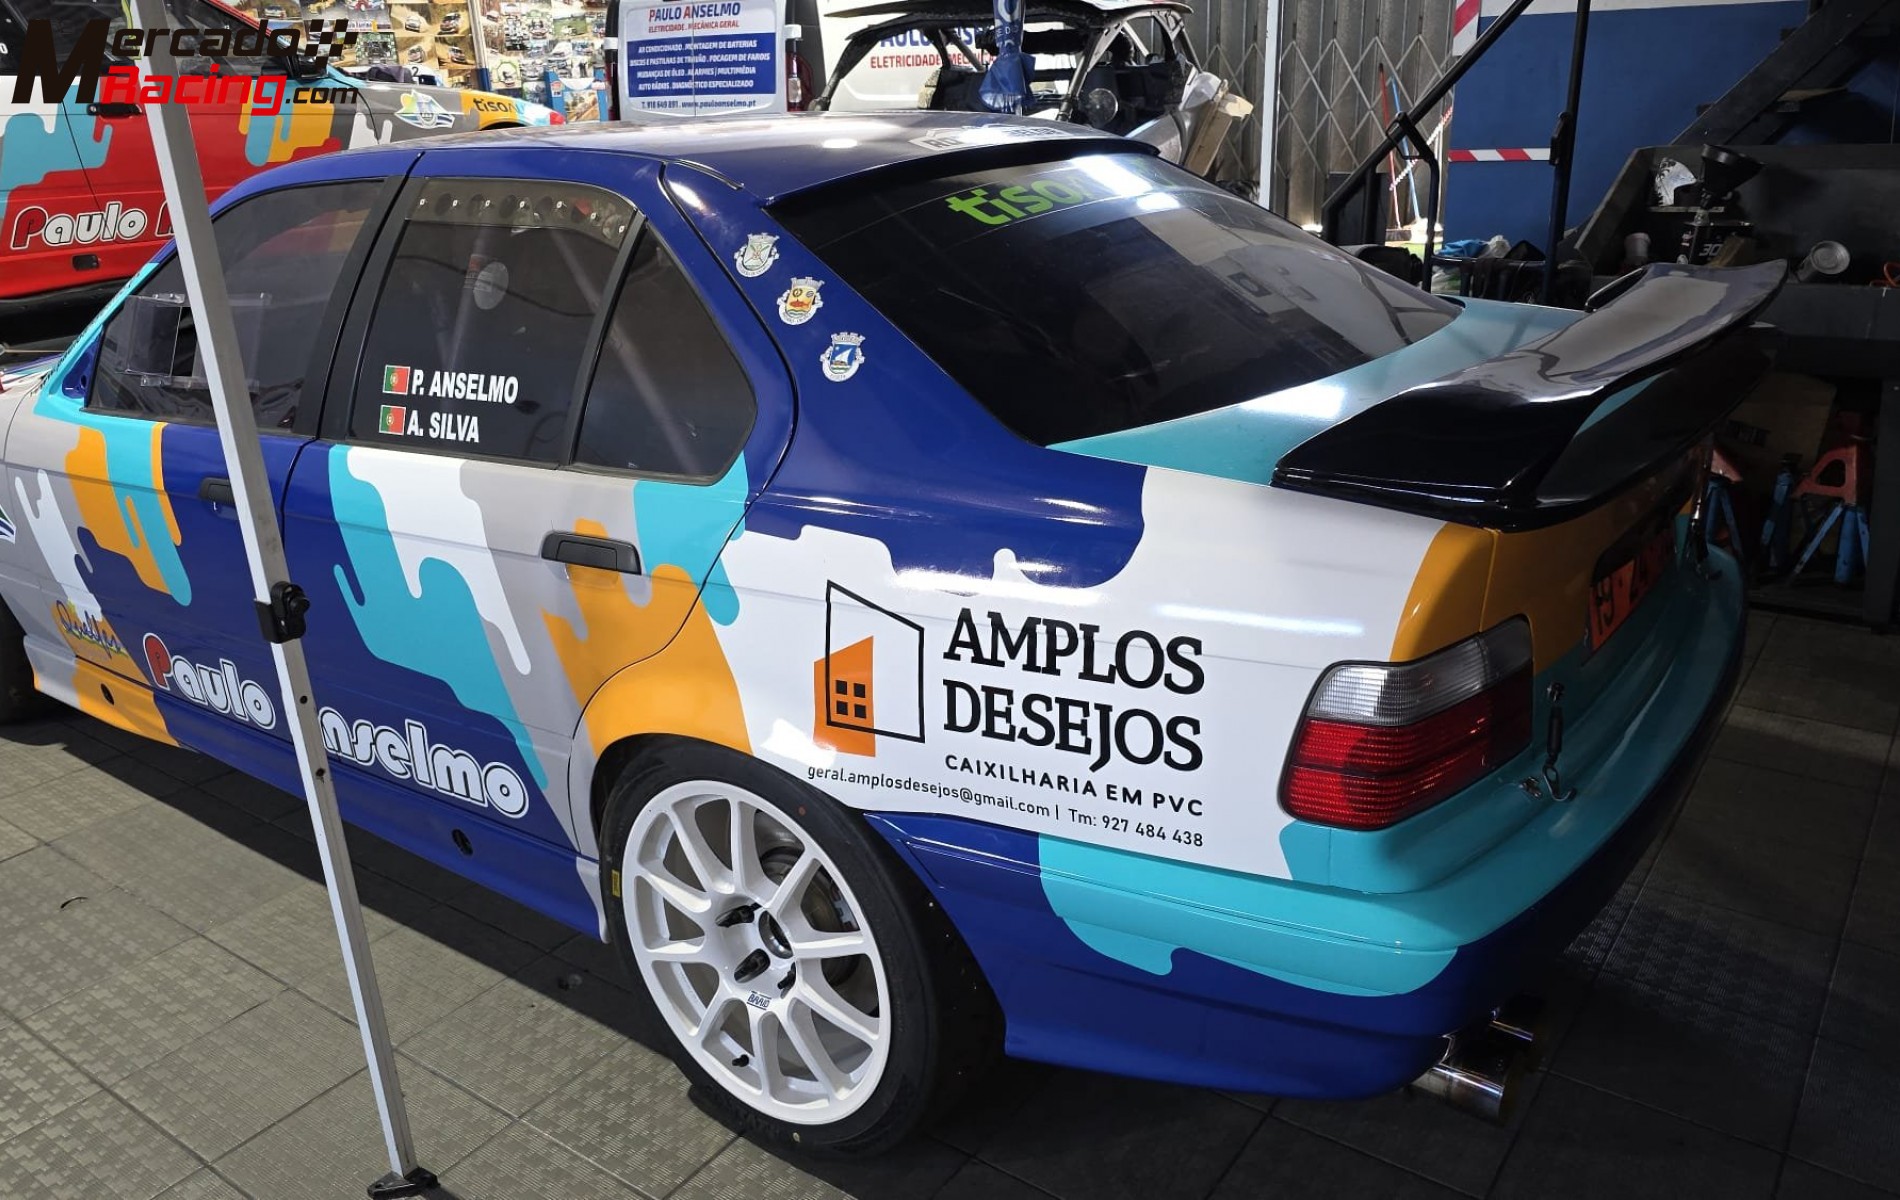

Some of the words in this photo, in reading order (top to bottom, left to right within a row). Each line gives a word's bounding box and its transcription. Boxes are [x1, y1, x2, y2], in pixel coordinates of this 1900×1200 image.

[648, 24, 685, 33] ELETRICIDADE
[720, 19, 740, 28] GERAL
[649, 7, 682, 22] PAULO
[683, 2, 741, 19] ANSELMO
[709, 54, 737, 62] FOCAGEM
[738, 53, 746, 61] DE
[719, 41, 726, 49] DE
[727, 40, 757, 48] BATERIAS
[709, 79, 754, 88] ESPECIALIZADO
[11, 201, 147, 249] Paulo
[411, 369, 424, 396] P.
[428, 371, 519, 404] ANSELMO
[407, 410, 424, 436] A.
[429, 412, 480, 443] SILVA
[943, 607, 1204, 695] AMPLOS
[143, 633, 276, 729] Paulo
[319, 706, 529, 818] nselmo
[943, 679, 1203, 773] DESEJOS
[945, 755, 1097, 797] CAIXILHARIA
[1106, 784, 1142, 806] EM
[1153, 792, 1203, 816] PVC
[808, 766, 1050, 817] geral.amplosdesejos@gmail.com
[1068, 808, 1097, 827] Tm:
[1102, 815, 1129, 833] 927
[1135, 822, 1166, 840] 484
[1172, 830, 1203, 847] 438
